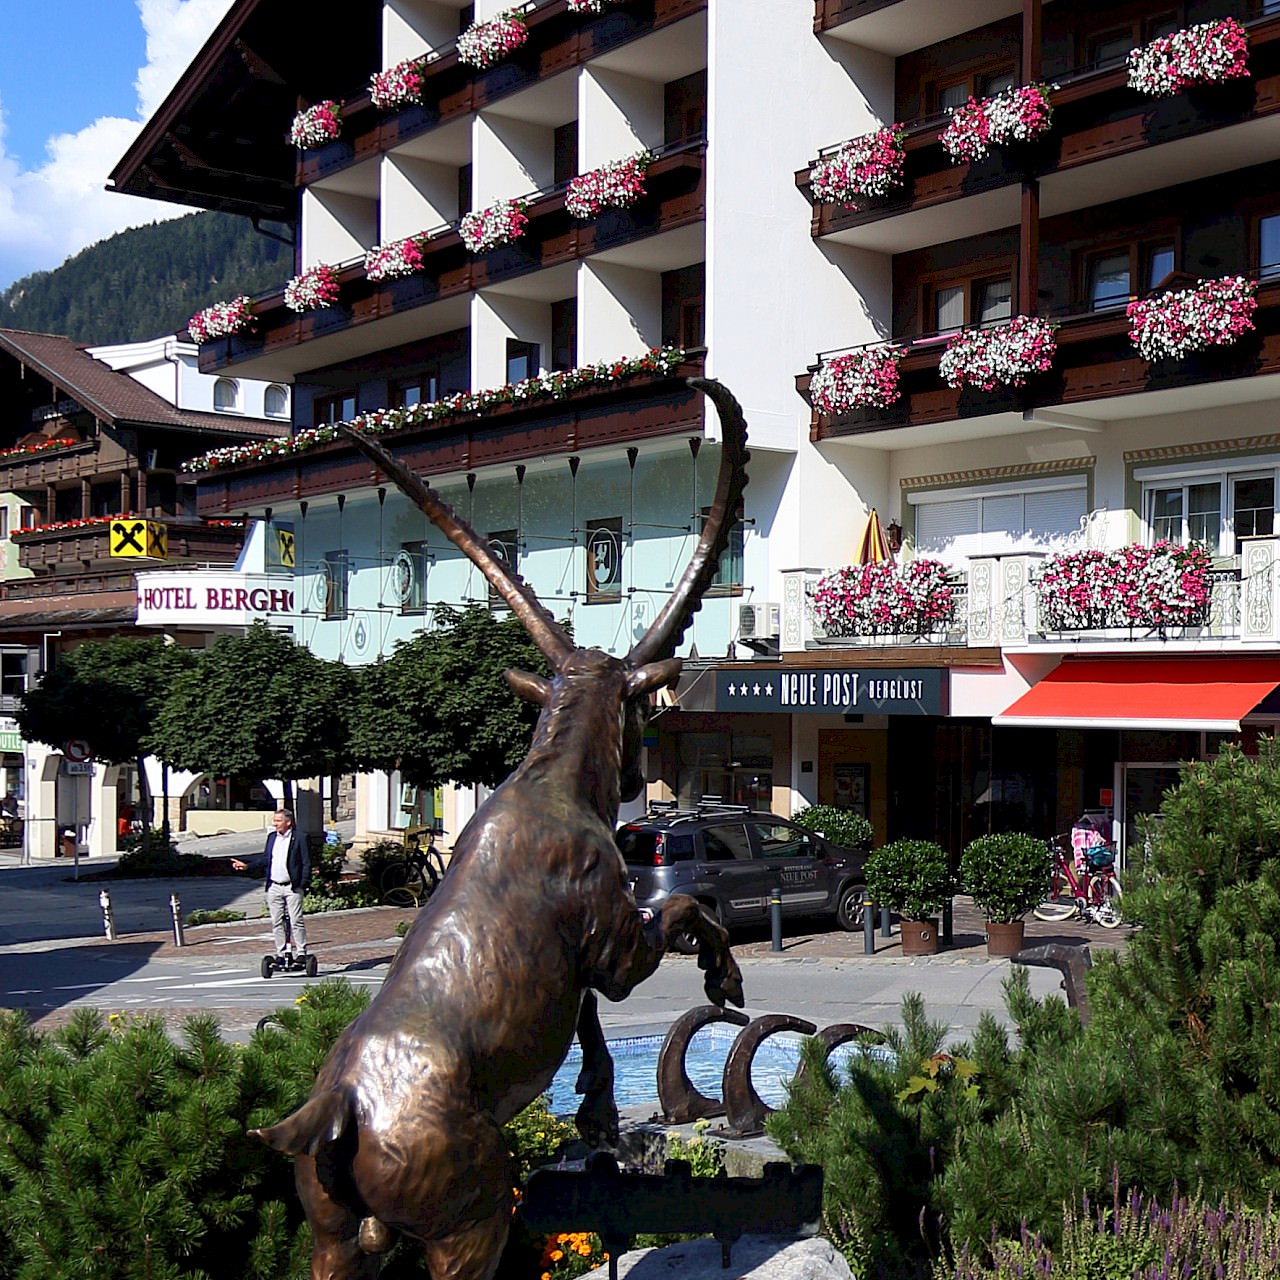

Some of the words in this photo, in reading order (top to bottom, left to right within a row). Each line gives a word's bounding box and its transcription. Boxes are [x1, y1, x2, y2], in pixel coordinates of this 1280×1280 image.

[143, 587, 197, 610] HOTEL
[823, 673, 859, 706] POST
[869, 680, 922, 699] BERGLUST
